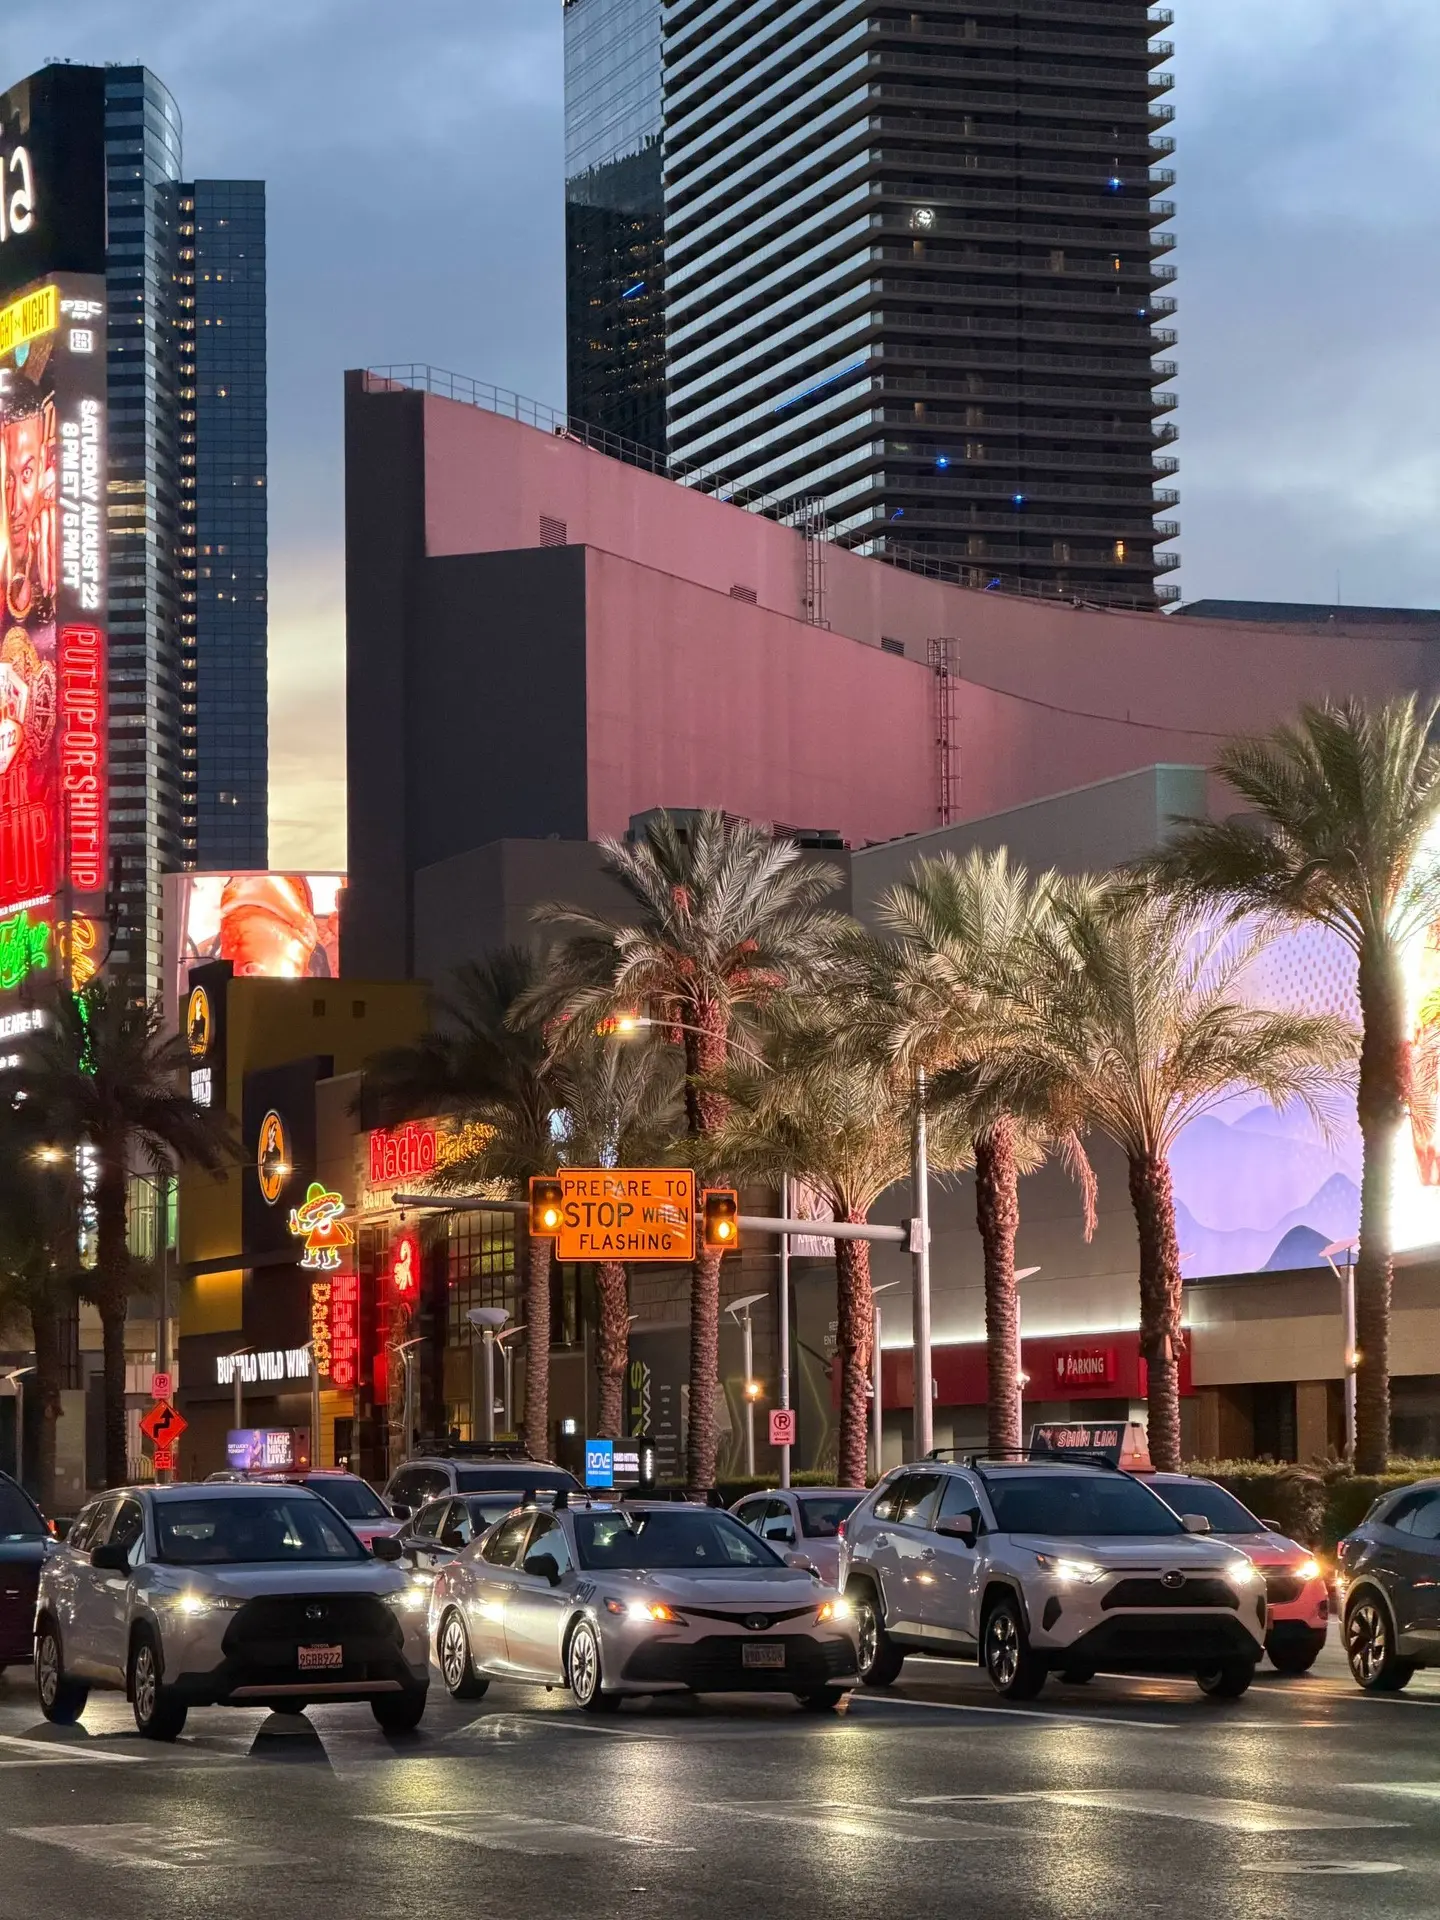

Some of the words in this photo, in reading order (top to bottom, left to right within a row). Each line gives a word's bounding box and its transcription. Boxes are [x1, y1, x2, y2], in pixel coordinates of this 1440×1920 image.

[22, 291, 51, 337] NIGHT
[60, 300, 103, 313] PBC
[81, 400, 98, 501] SATURDAY
[81, 502, 98, 582] AUGUST
[81, 583, 98, 609] 22
[64, 628, 98, 680] PUT
[64, 689, 98, 724] UP
[64, 732, 98, 767] OR
[370, 1126, 435, 1182] Nacho
[564, 1180, 652, 1197] PREPARE
[665, 1180, 687, 1197] TO
[564, 1203, 634, 1228] STOP
[642, 1207, 688, 1223] WHEN
[580, 1234, 672, 1250] FLASHING
[333, 1276, 358, 1384] Nacho
[257, 1351, 284, 1381] WILD
[1067, 1357, 1104, 1375] PARKING
[266, 1435, 290, 1444] MAGIC
[266, 1444, 287, 1454] MIKE
[1057, 1430, 1090, 1447] SHIN
[1093, 1430, 1118, 1447] LIM
[156, 1452, 170, 1461] 25
[267, 1454, 286, 1464] LIVE
[587, 1452, 611, 1468] ROVE
